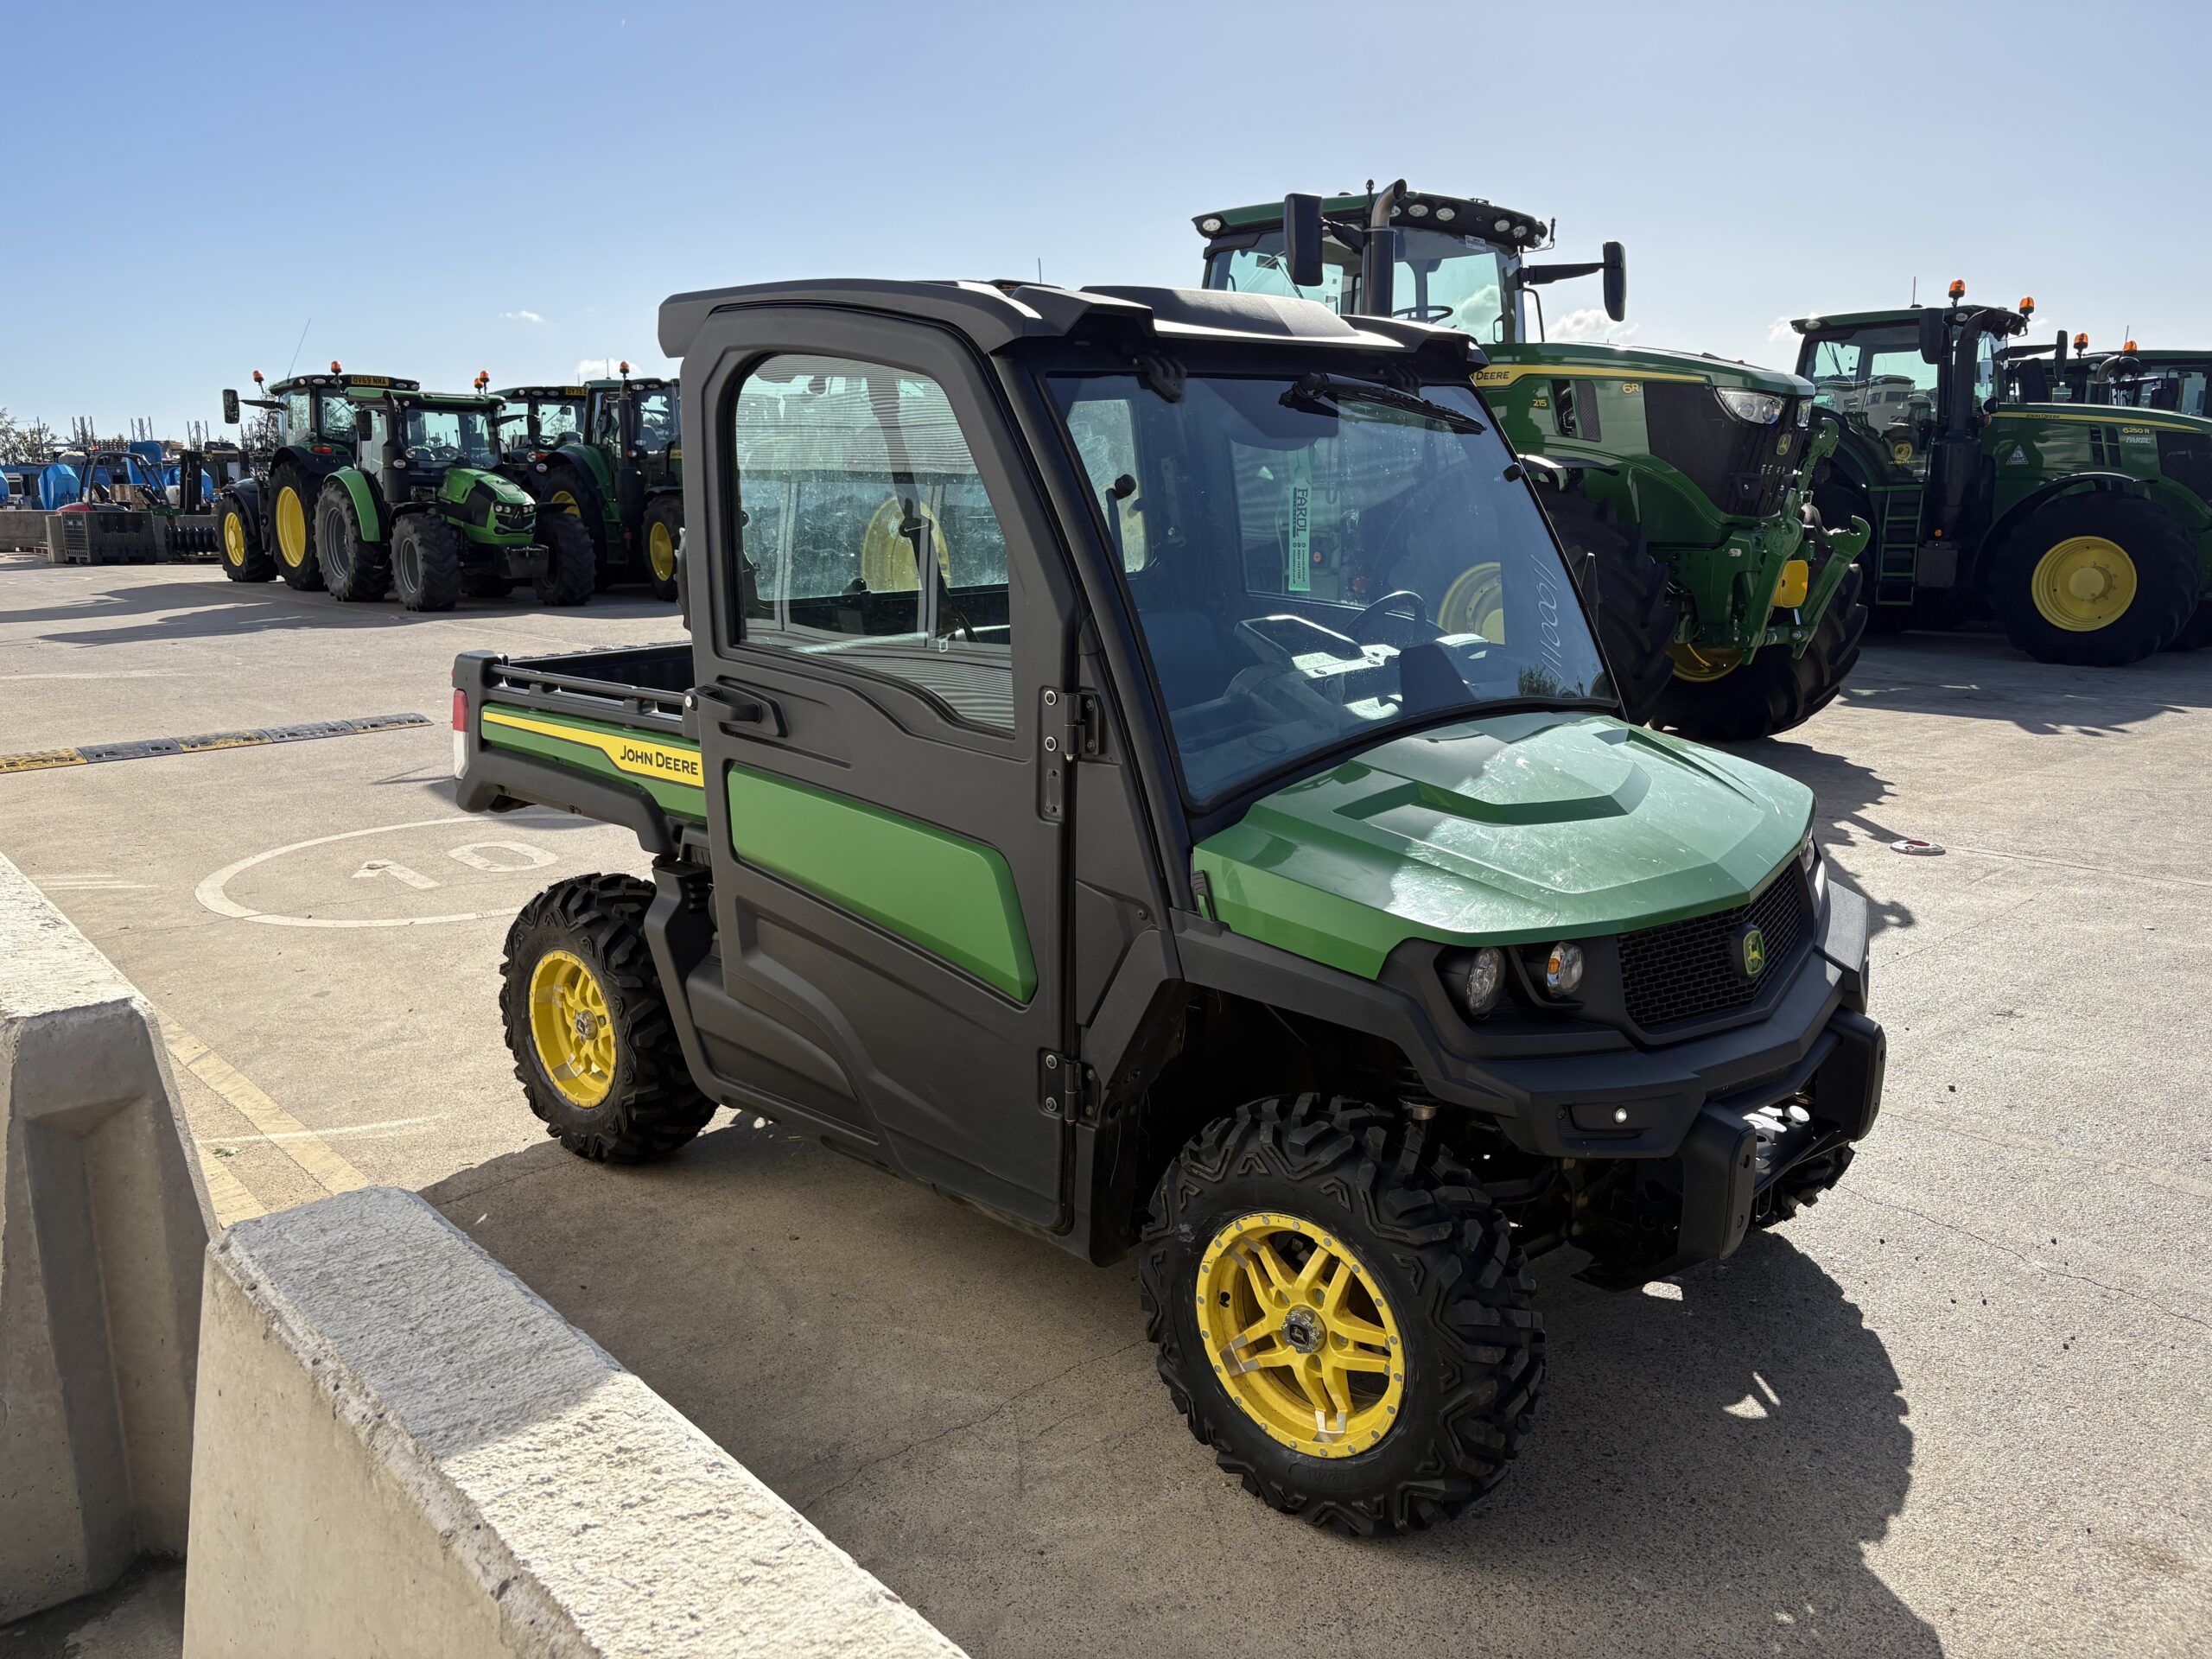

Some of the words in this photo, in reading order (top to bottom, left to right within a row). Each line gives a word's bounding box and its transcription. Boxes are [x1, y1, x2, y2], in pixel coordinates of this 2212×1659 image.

[1476, 371, 1510, 380] DEERE
[1622, 383, 1640, 394] 6R
[1532, 398, 1548, 408] 215
[1297, 487, 1308, 537] FAROL
[620, 745, 653, 766] JOHN
[655, 751, 699, 776] DEERE
